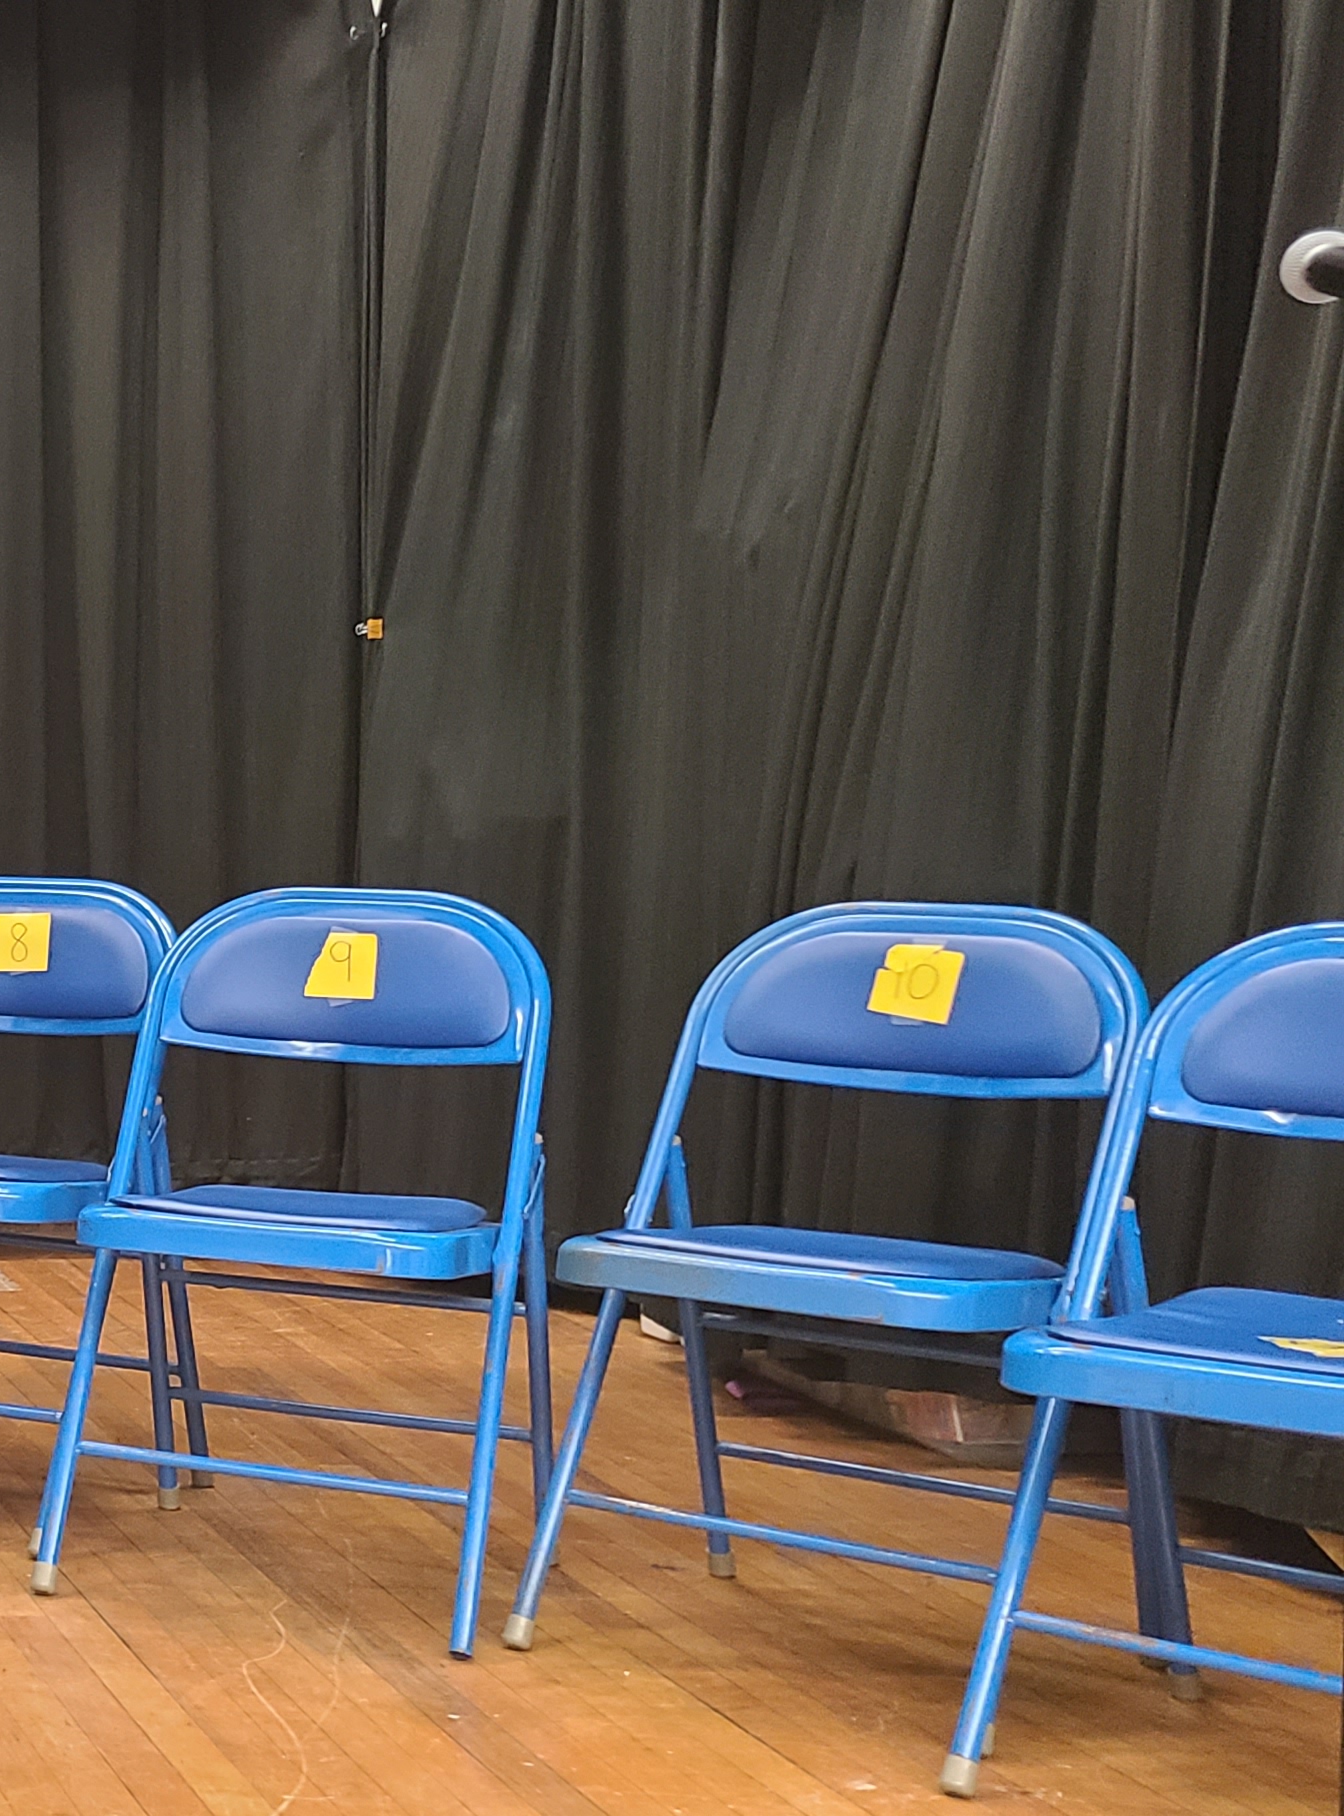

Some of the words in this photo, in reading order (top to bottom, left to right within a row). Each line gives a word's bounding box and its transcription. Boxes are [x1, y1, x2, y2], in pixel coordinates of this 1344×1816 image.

[10, 922, 29, 963] 8
[329, 940, 352, 983] 9
[893, 961, 940, 1000] 10
